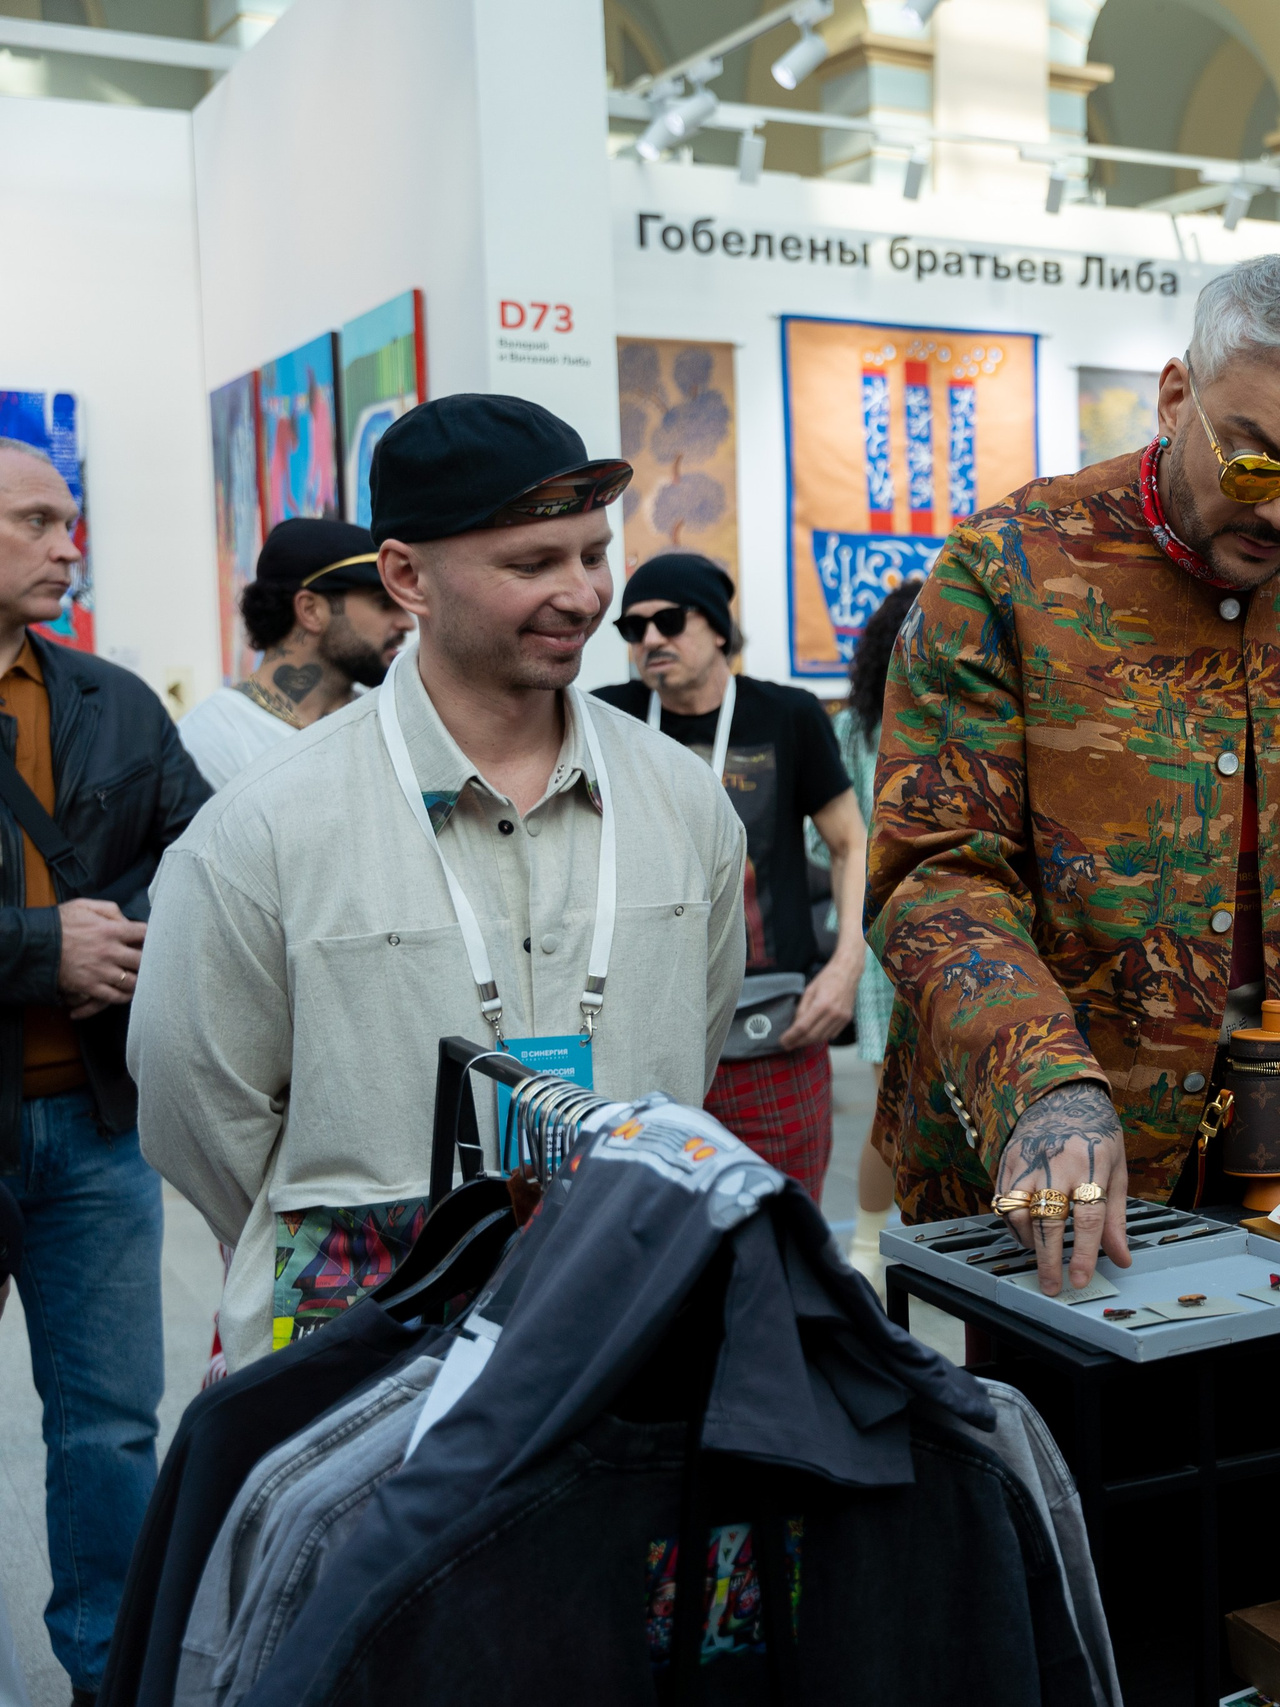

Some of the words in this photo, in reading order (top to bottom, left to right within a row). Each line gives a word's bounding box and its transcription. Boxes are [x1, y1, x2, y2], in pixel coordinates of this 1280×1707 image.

[637, 212, 870, 269] Гобелены
[889, 236, 1064, 284] братьев
[1078, 256, 1180, 297] Либа
[499, 299, 574, 334] D73
[528, 1048, 569, 1058] СИНЕРГИЯ
[542, 1067, 576, 1076] РОССИЯ
